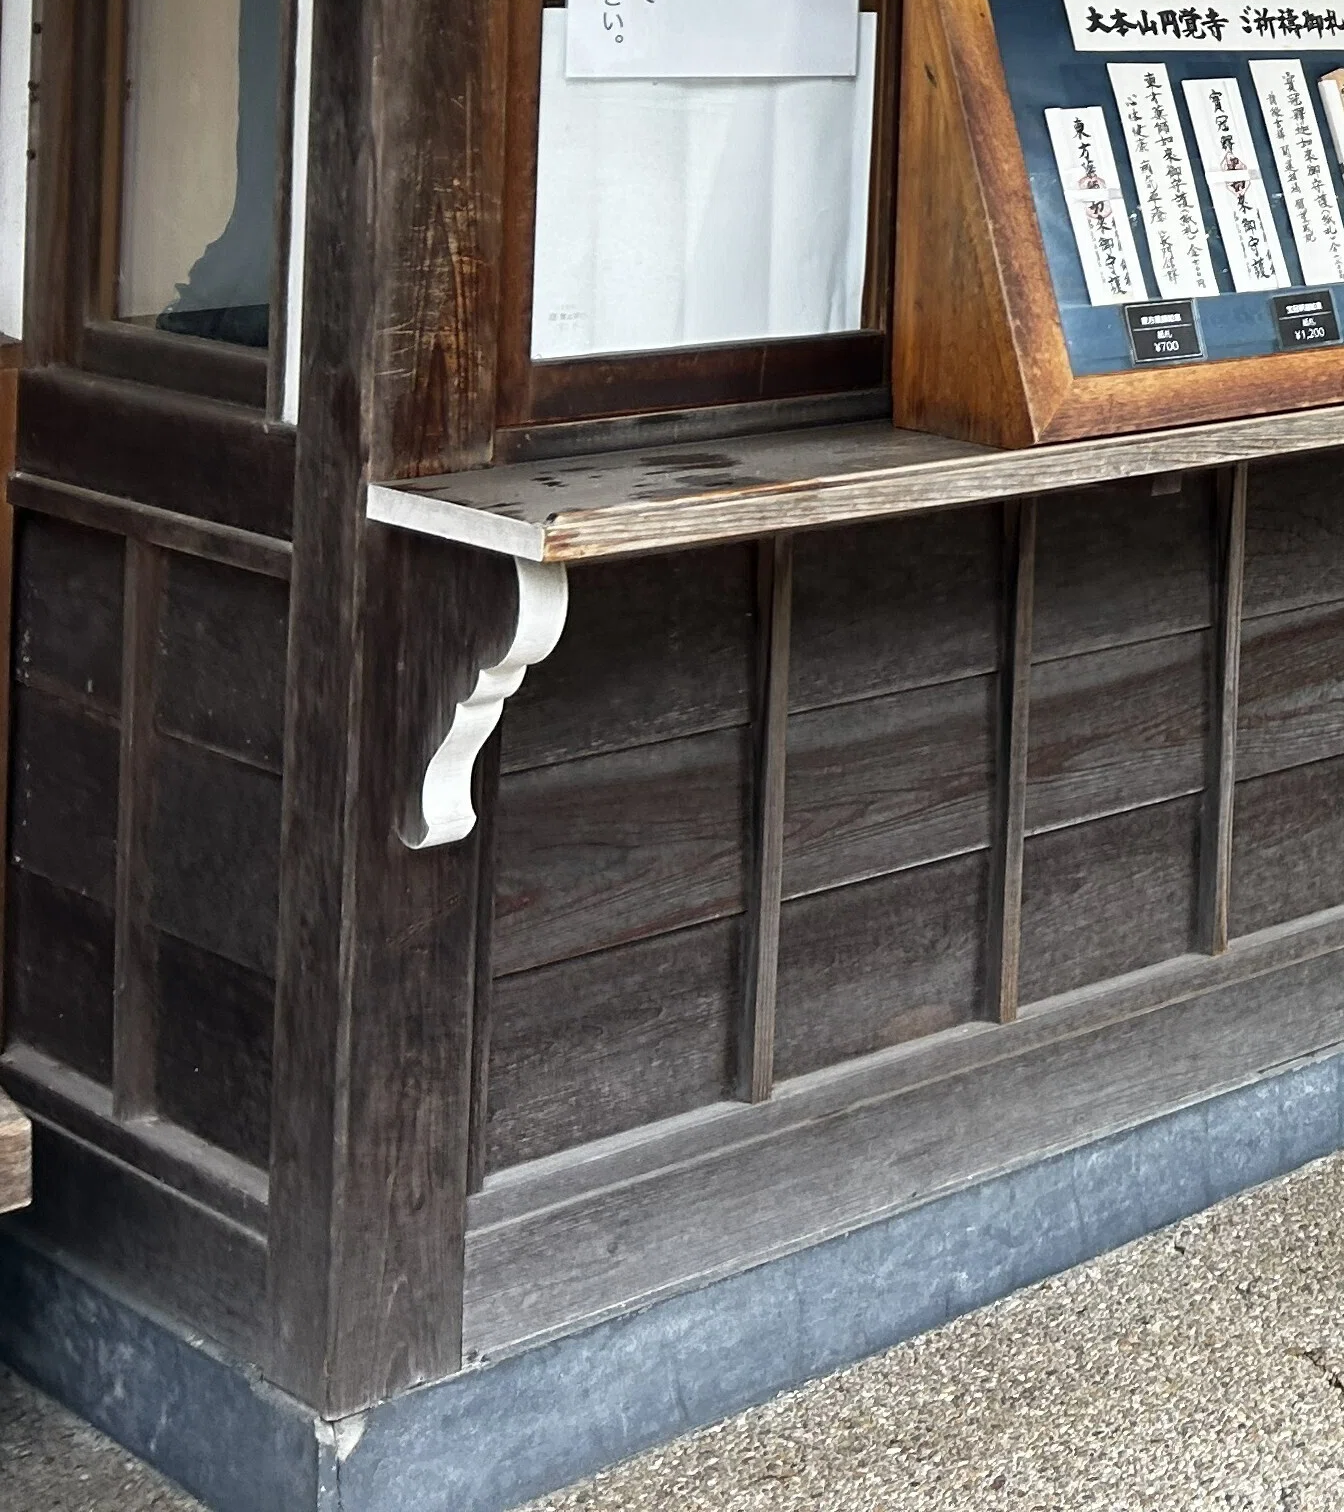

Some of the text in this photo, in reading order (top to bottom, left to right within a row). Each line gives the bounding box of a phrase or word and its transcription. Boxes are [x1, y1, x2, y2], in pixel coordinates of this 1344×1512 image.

[1085, 6, 1230, 42] 大本山円覚寺
[1294, 326, 1325, 341] ¥1,200
[1154, 340, 1180, 353] ¥700
